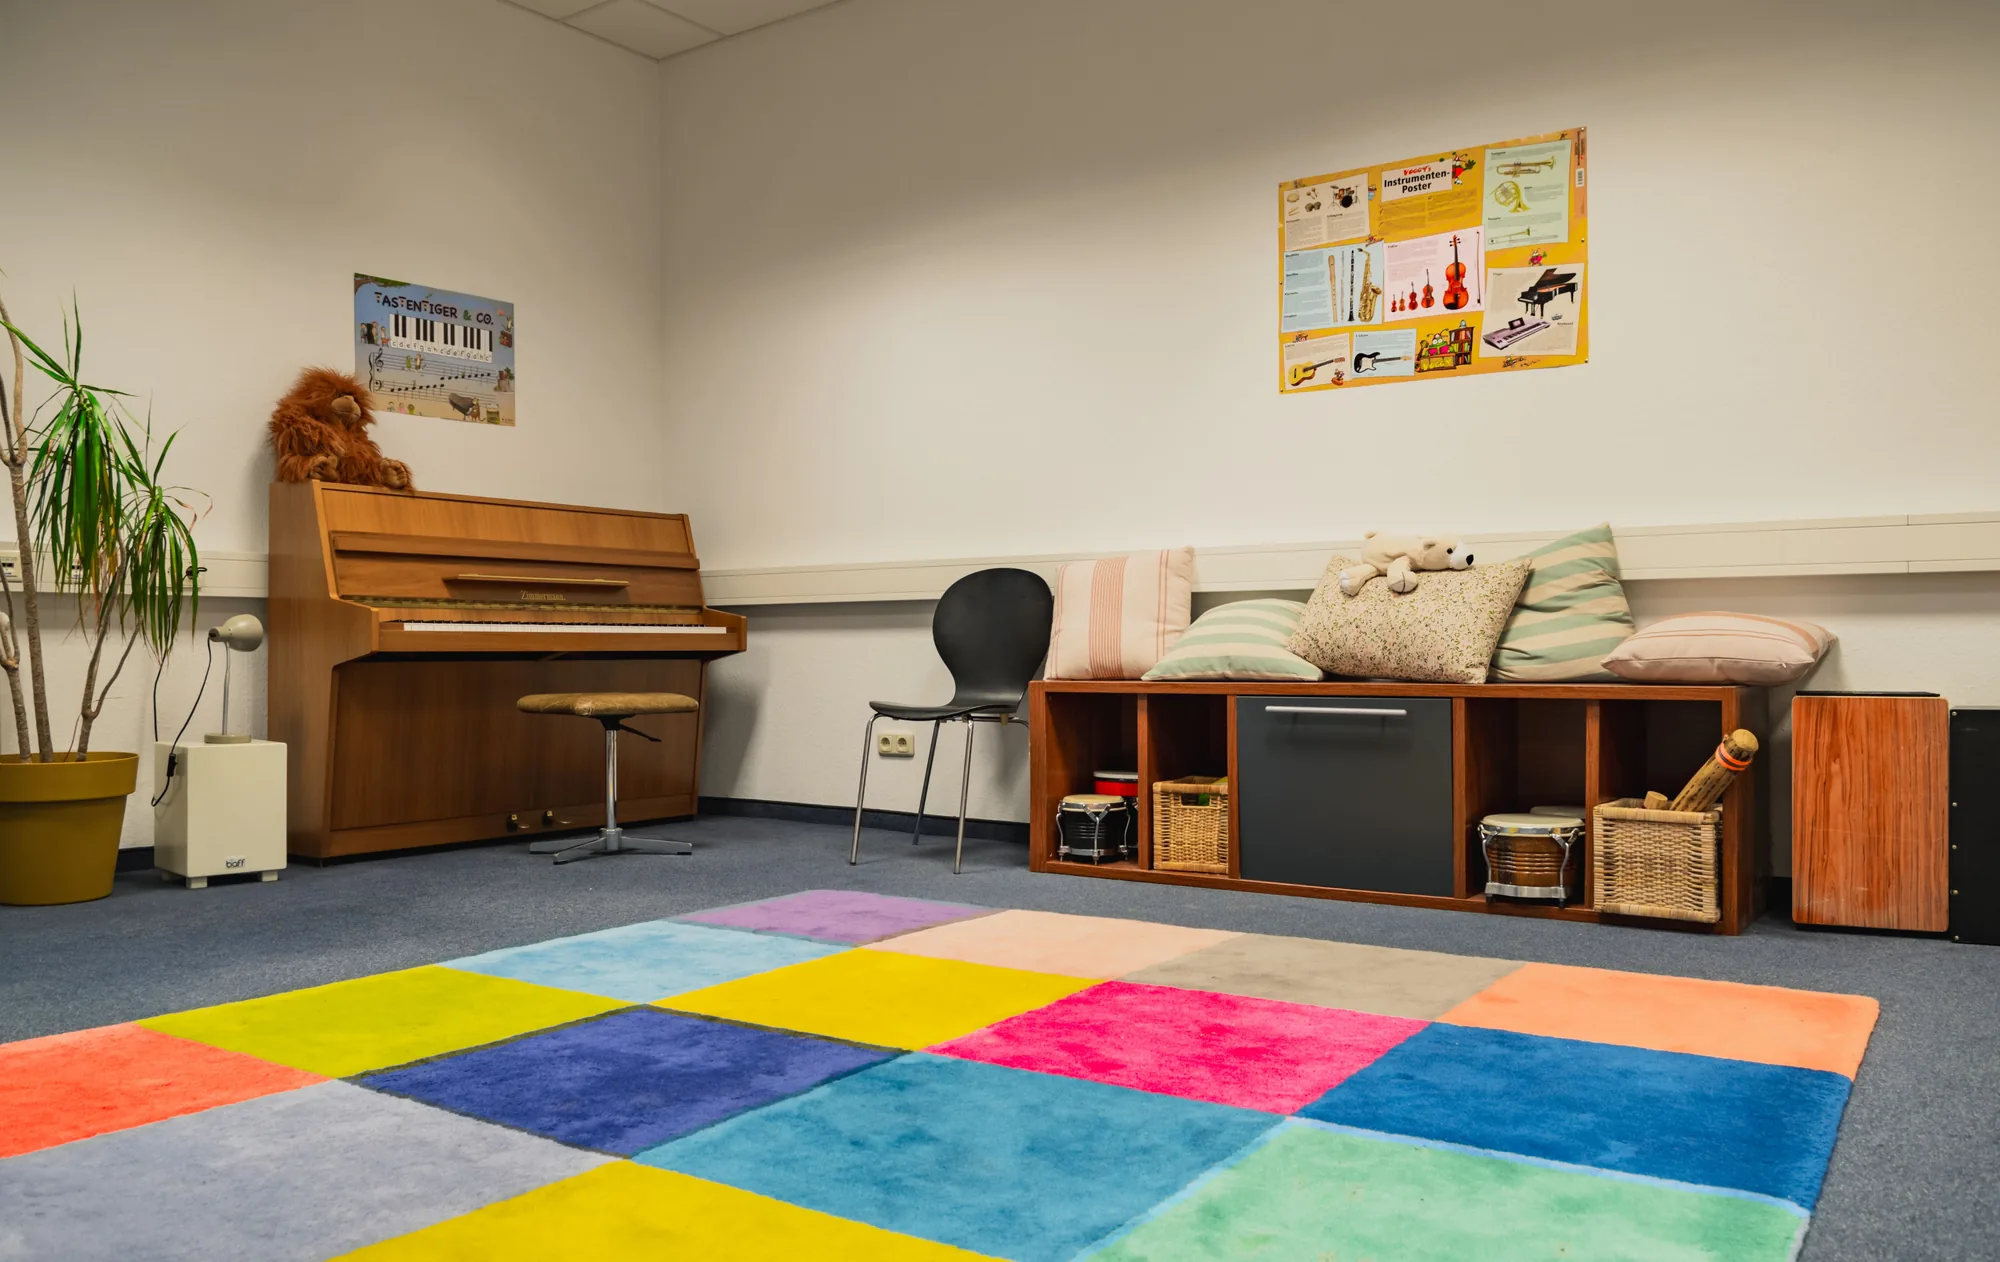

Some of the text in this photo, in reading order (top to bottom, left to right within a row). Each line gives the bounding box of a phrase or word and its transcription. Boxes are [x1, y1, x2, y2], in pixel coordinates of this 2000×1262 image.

[1384, 170, 1451, 188] Instrumenten-
[1402, 182, 1432, 194] Poster
[374, 291, 494, 326] TASTENTIGER & CO.
[225, 858, 246, 869] baff
